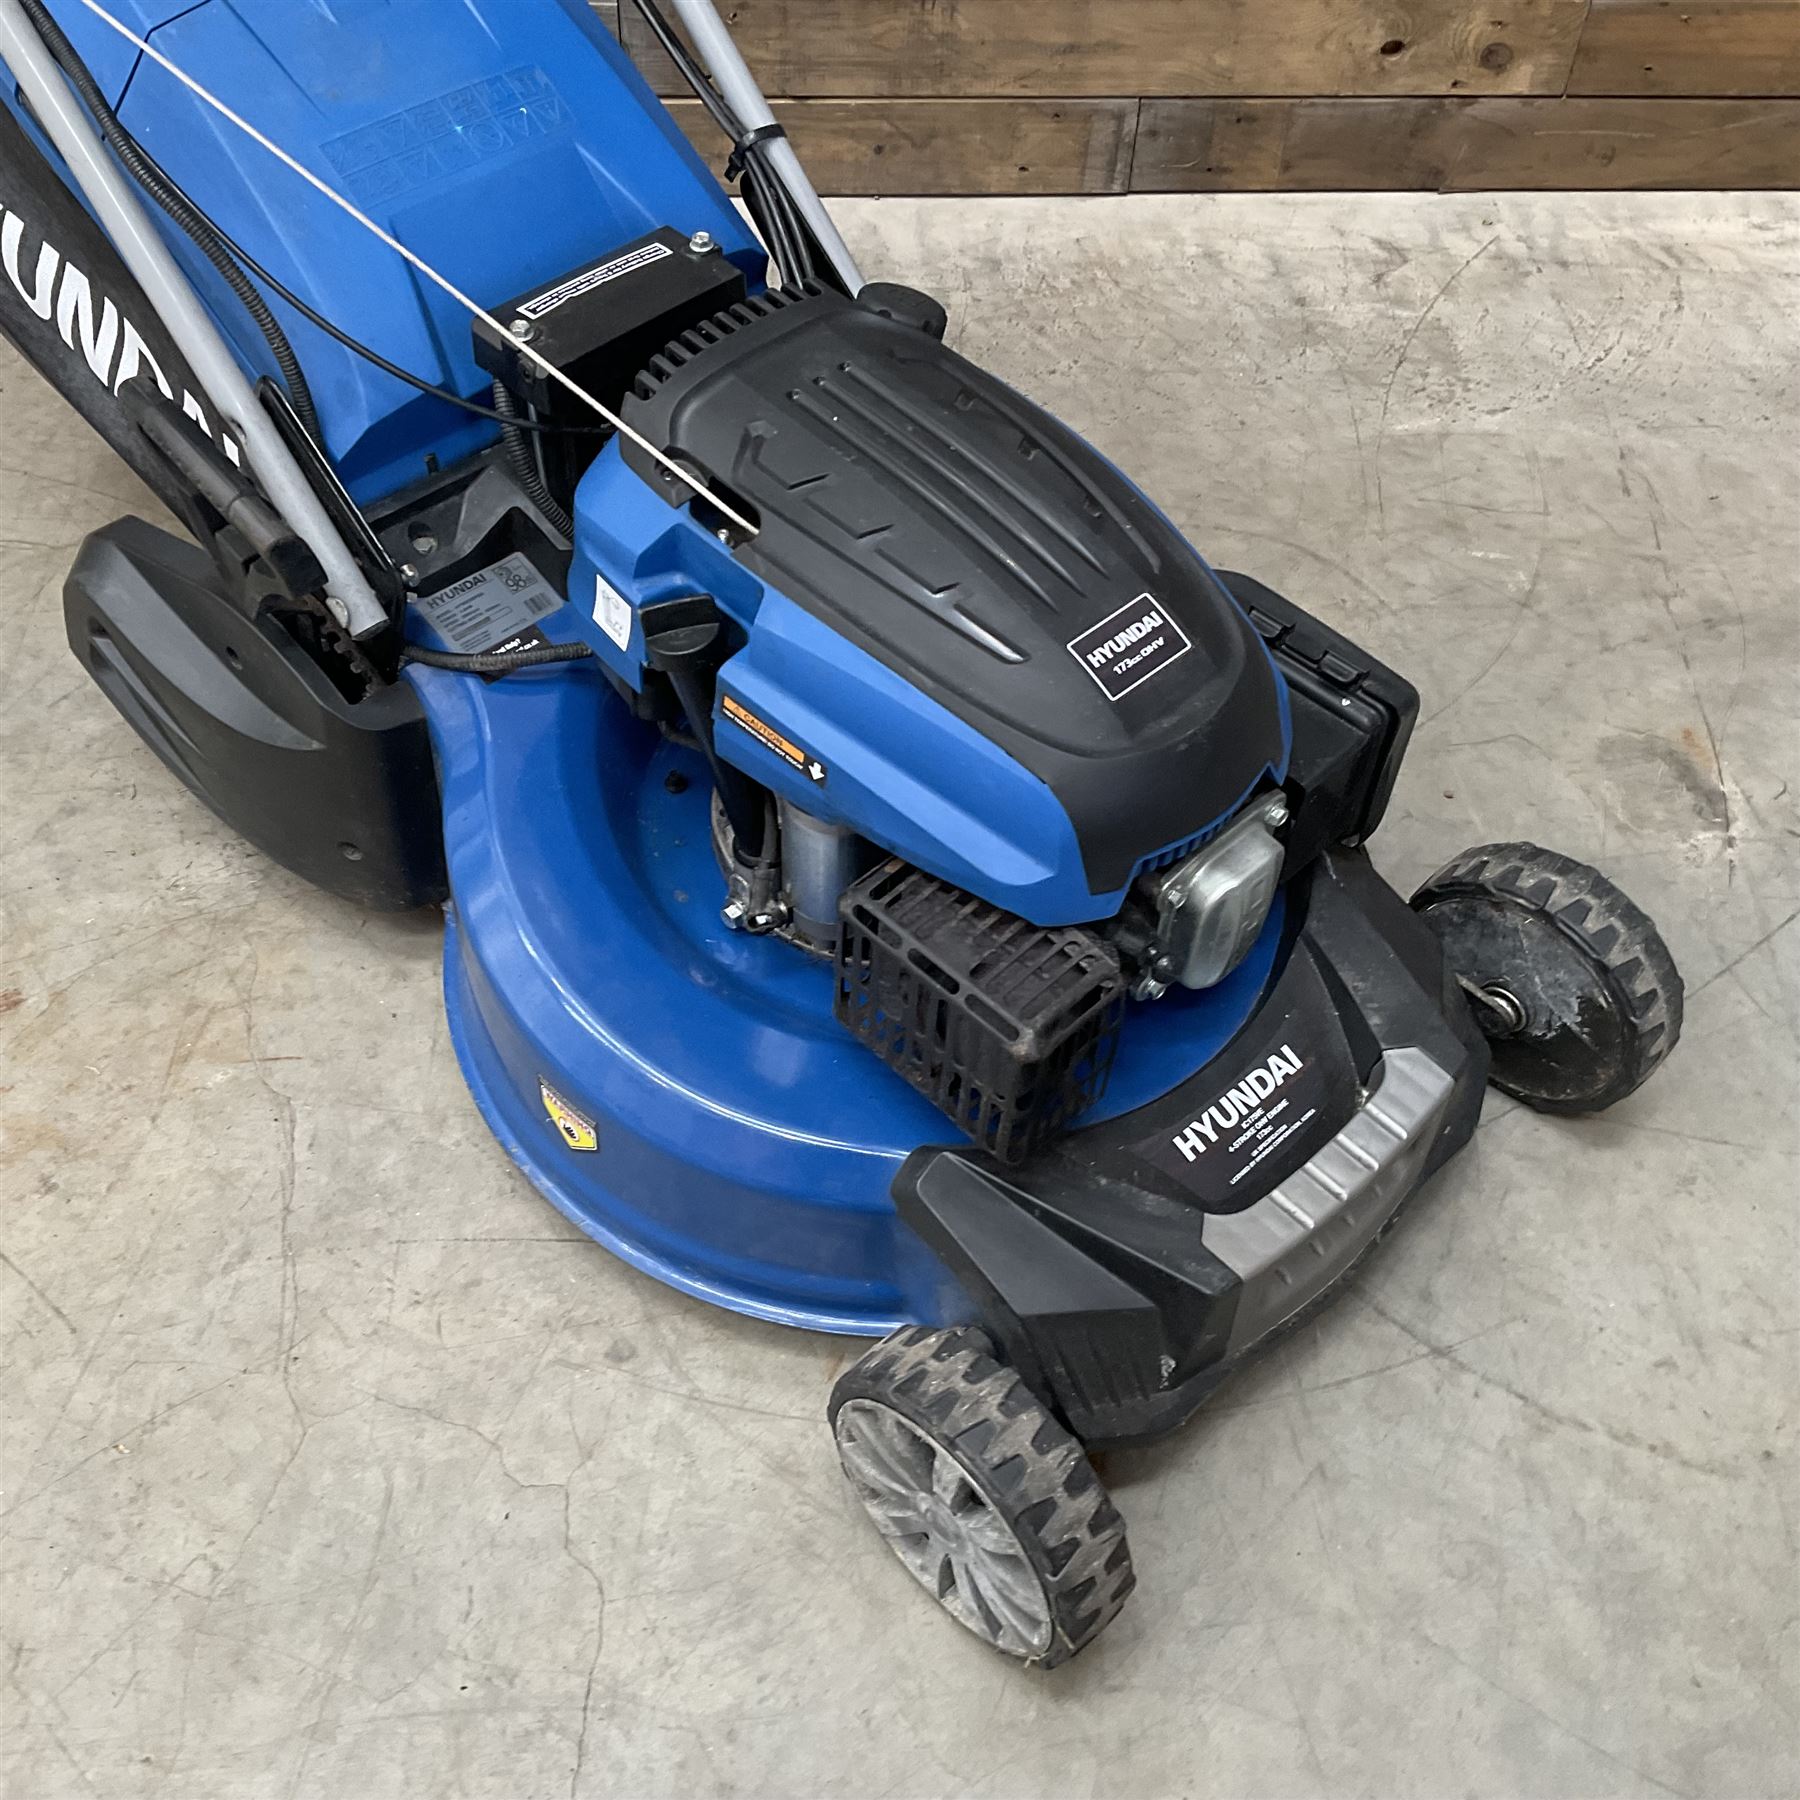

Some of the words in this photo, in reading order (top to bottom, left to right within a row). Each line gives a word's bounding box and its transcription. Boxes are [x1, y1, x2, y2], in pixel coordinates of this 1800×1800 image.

[427, 573, 487, 609] HYUNDAI
[505, 574, 528, 593] 98
[1086, 610, 1164, 668] HYUNDAI
[744, 713, 784, 746] CAUTION
[1173, 1045, 1303, 1162] HYUNDAI
[1227, 1125, 1257, 1153] 4-STROKE
[1266, 1098, 1289, 1119] ENGINE
